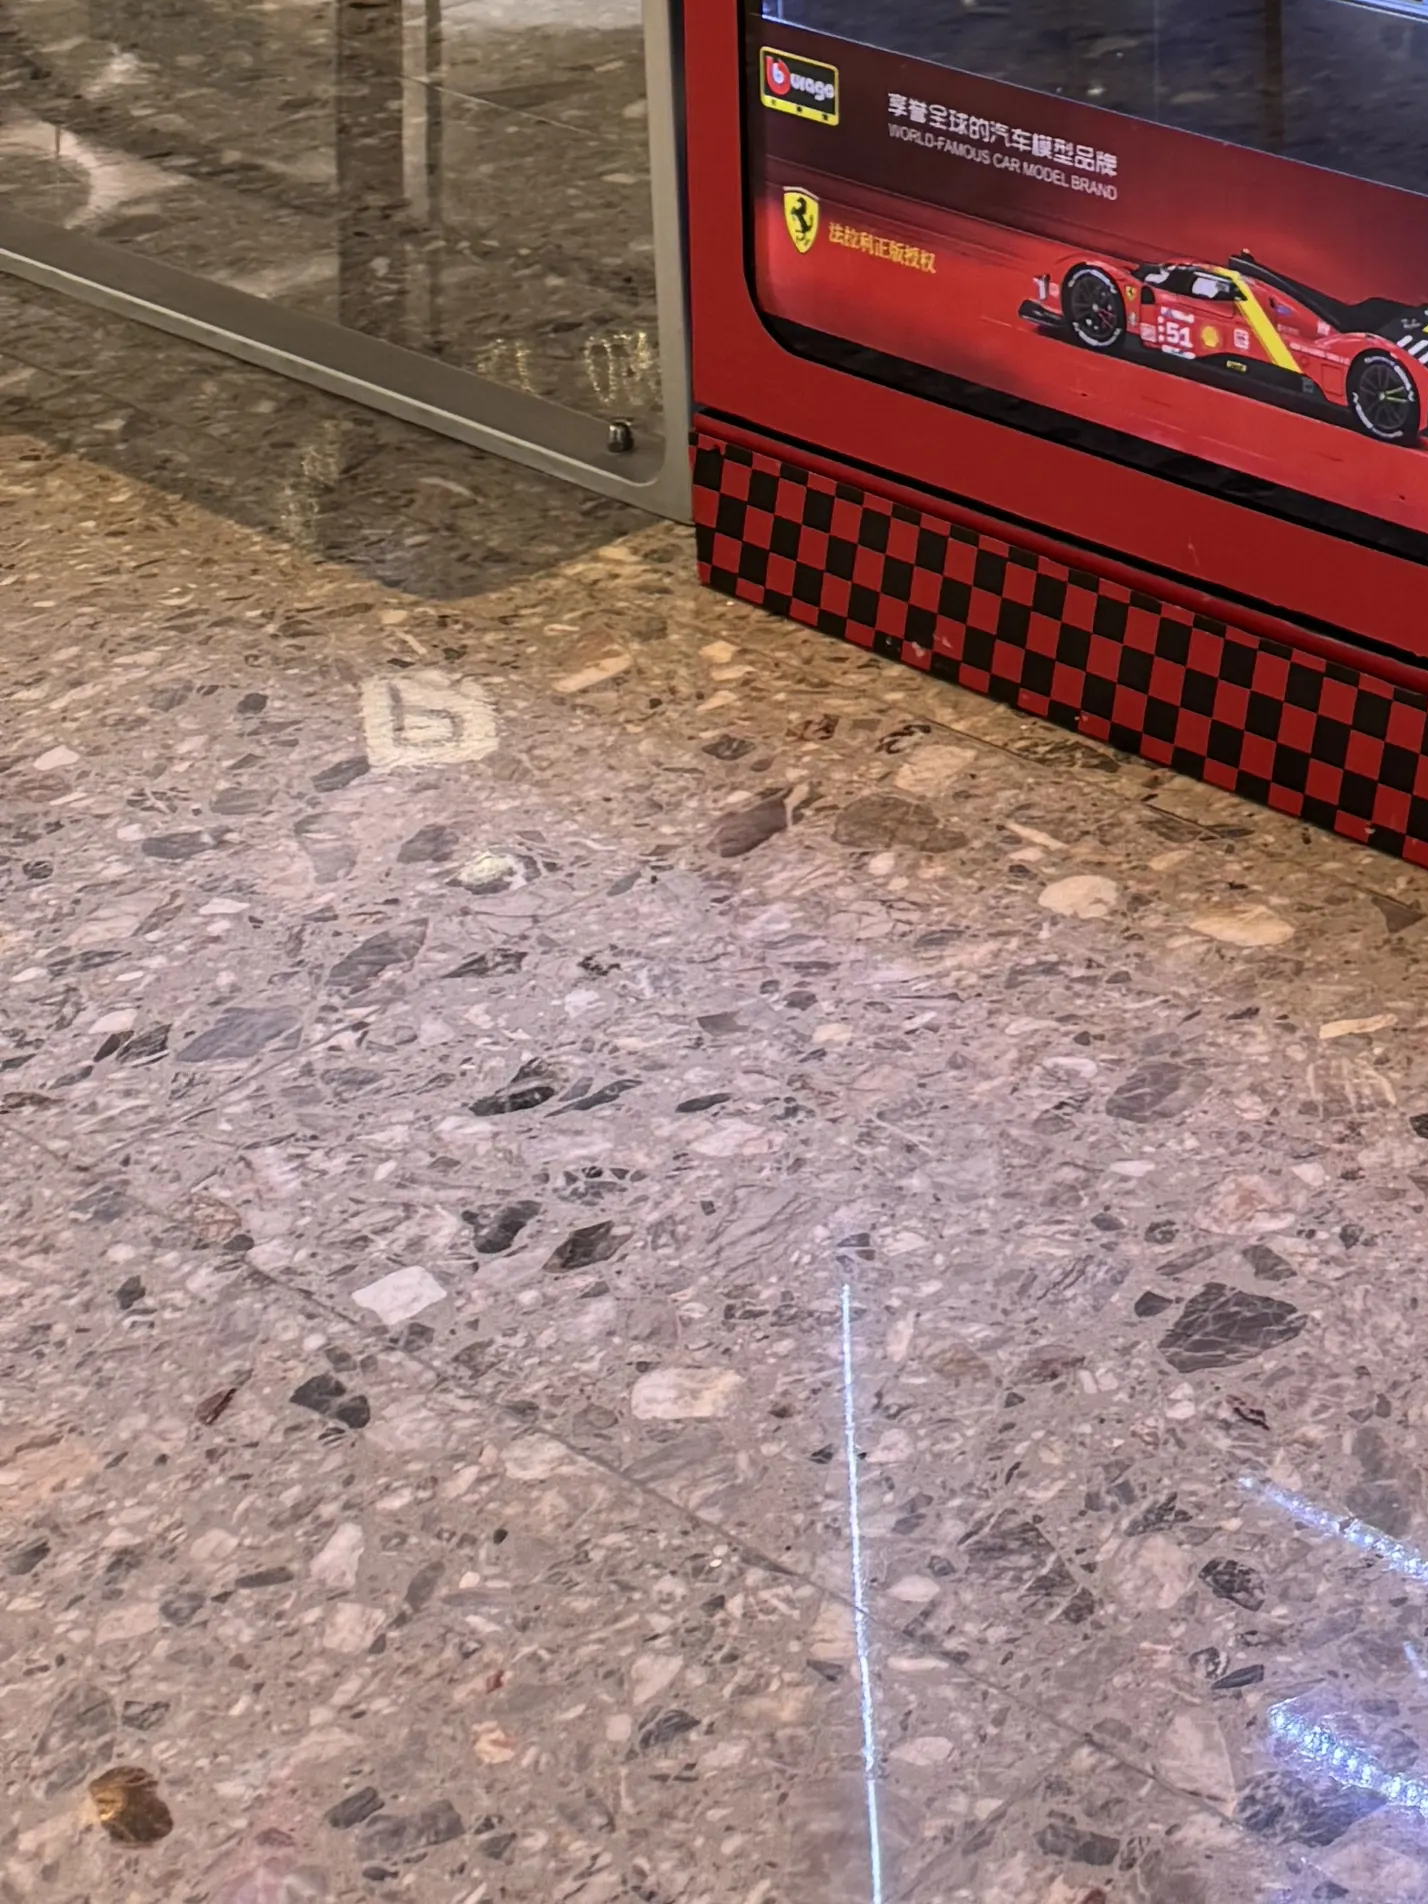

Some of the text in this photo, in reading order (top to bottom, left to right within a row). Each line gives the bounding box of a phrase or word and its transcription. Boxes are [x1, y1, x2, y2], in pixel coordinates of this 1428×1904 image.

[886, 91, 1119, 178] 享誉全球的汽车模型品牌
[887, 122, 1119, 202] WORLD-FAMOUS CAR MODEL BRAND
